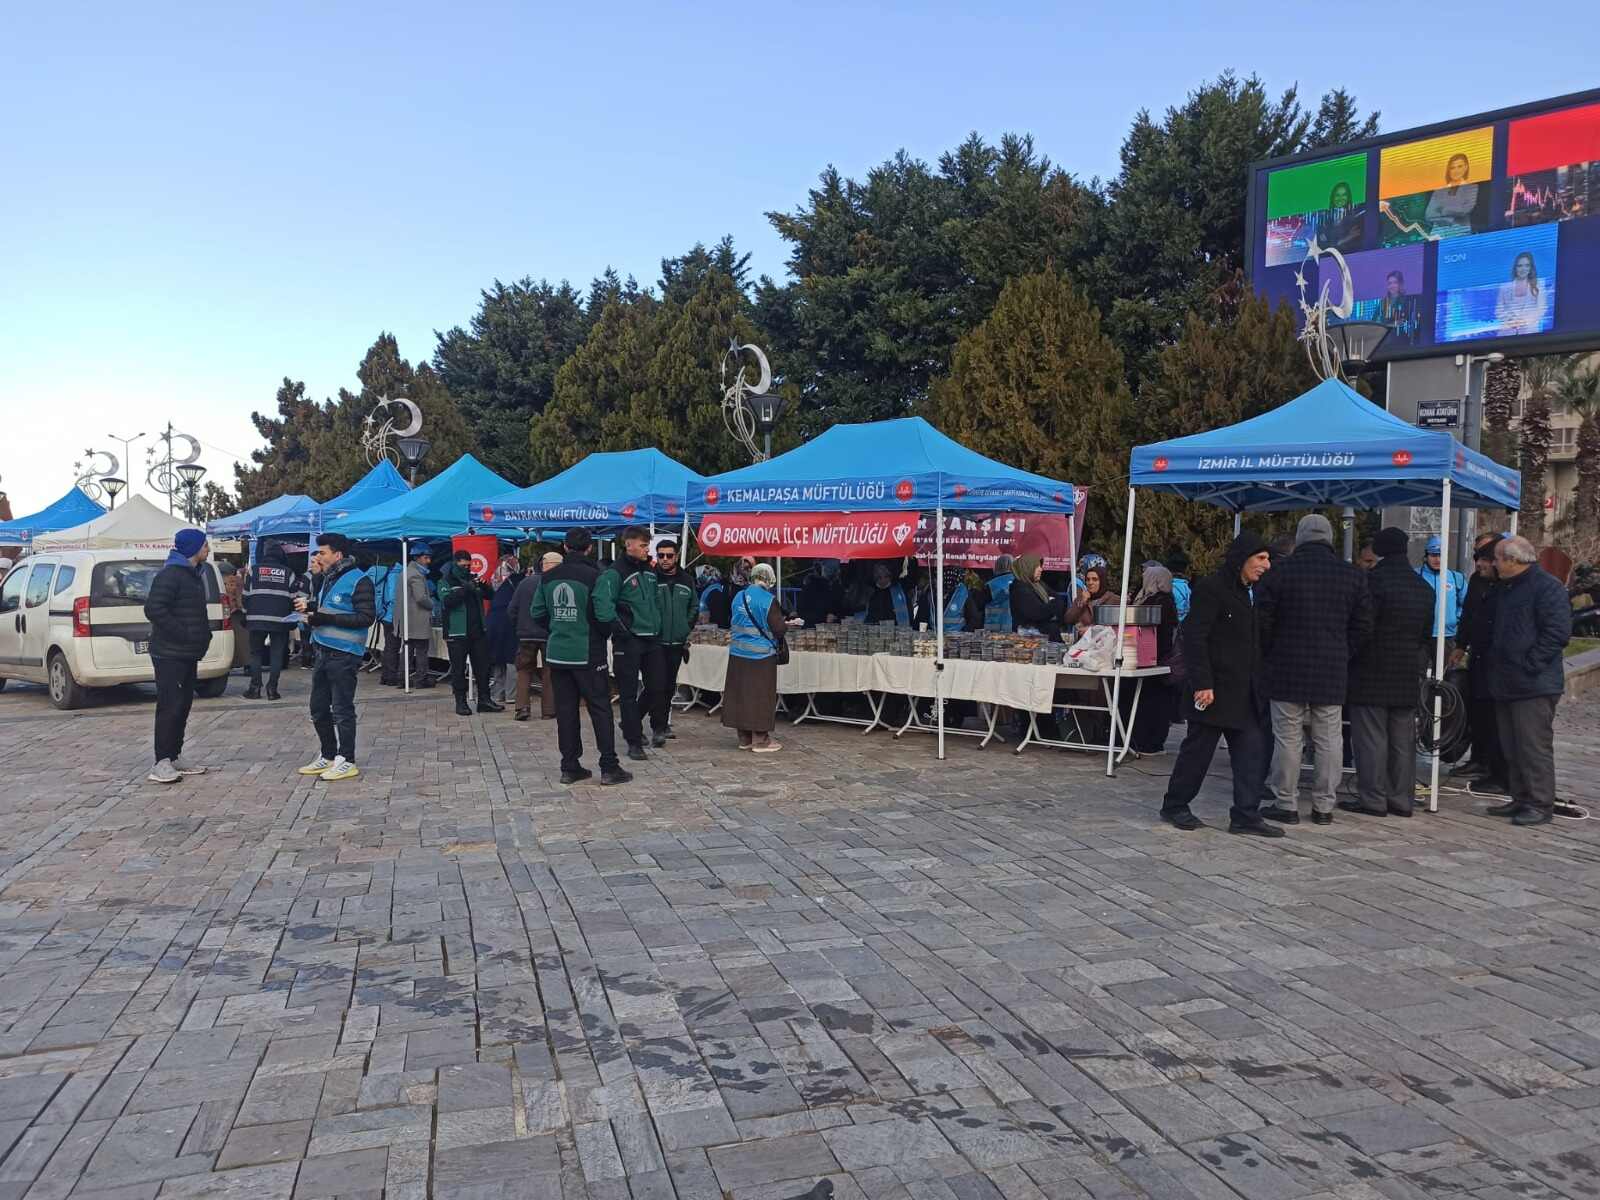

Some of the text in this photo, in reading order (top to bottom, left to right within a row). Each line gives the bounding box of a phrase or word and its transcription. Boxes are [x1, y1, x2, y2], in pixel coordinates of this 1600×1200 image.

[1198, 452, 1355, 469] İZMİR İL MÜFTÜLÜĞÜ
[727, 481, 885, 505] KEMALPAŞA MÜFTÜLÜĞÜ
[505, 505, 609, 521] BAYRAKLI MÜFTÜLÜĞÜ
[723, 522, 888, 549] BORNOVA İLÇE MÜFTÜLÜĞÜ
